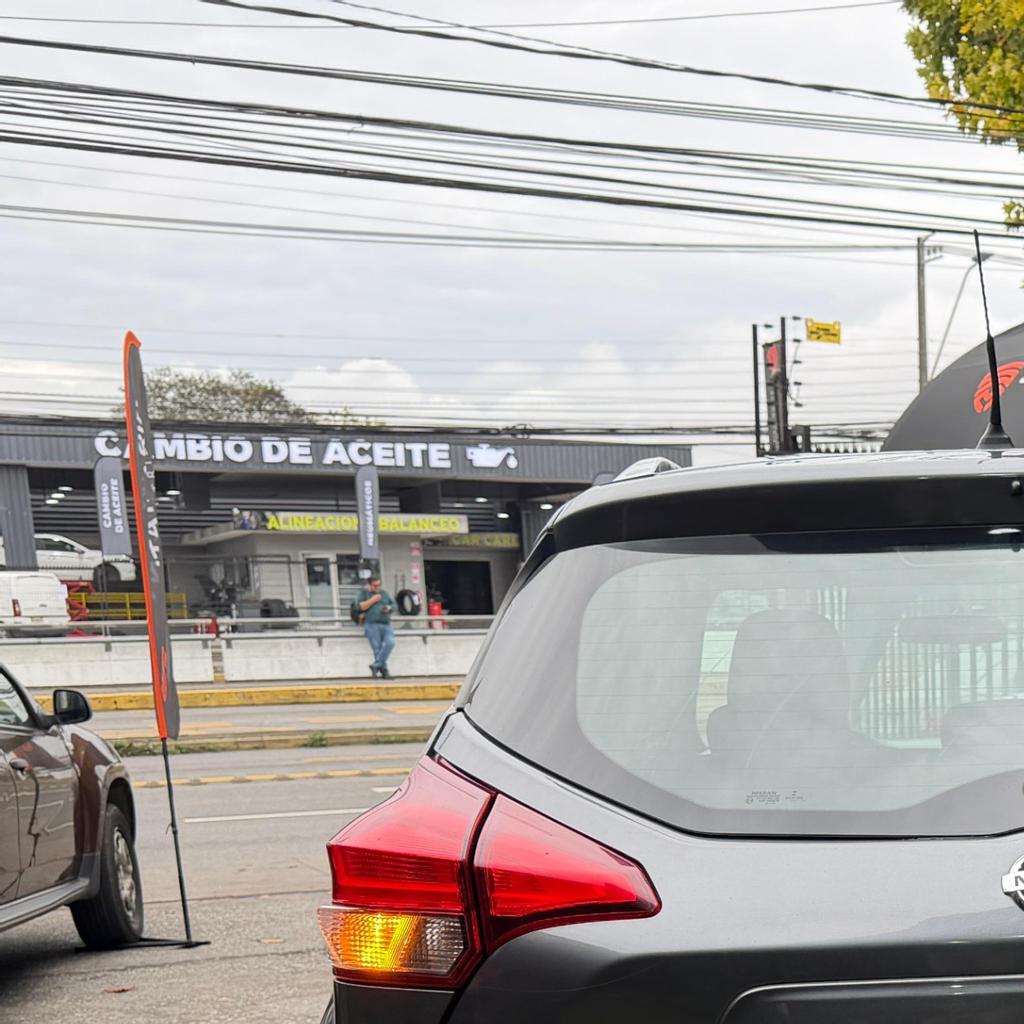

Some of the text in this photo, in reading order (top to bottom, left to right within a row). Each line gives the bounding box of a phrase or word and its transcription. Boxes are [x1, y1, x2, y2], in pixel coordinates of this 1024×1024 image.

[261, 436, 313, 464] DE
[322, 438, 451, 468] ACEITE
[101, 482, 112, 528] CAMBIO
[110, 478, 124, 533] DE ACEITE
[378, 517, 461, 531] BALANCEO
